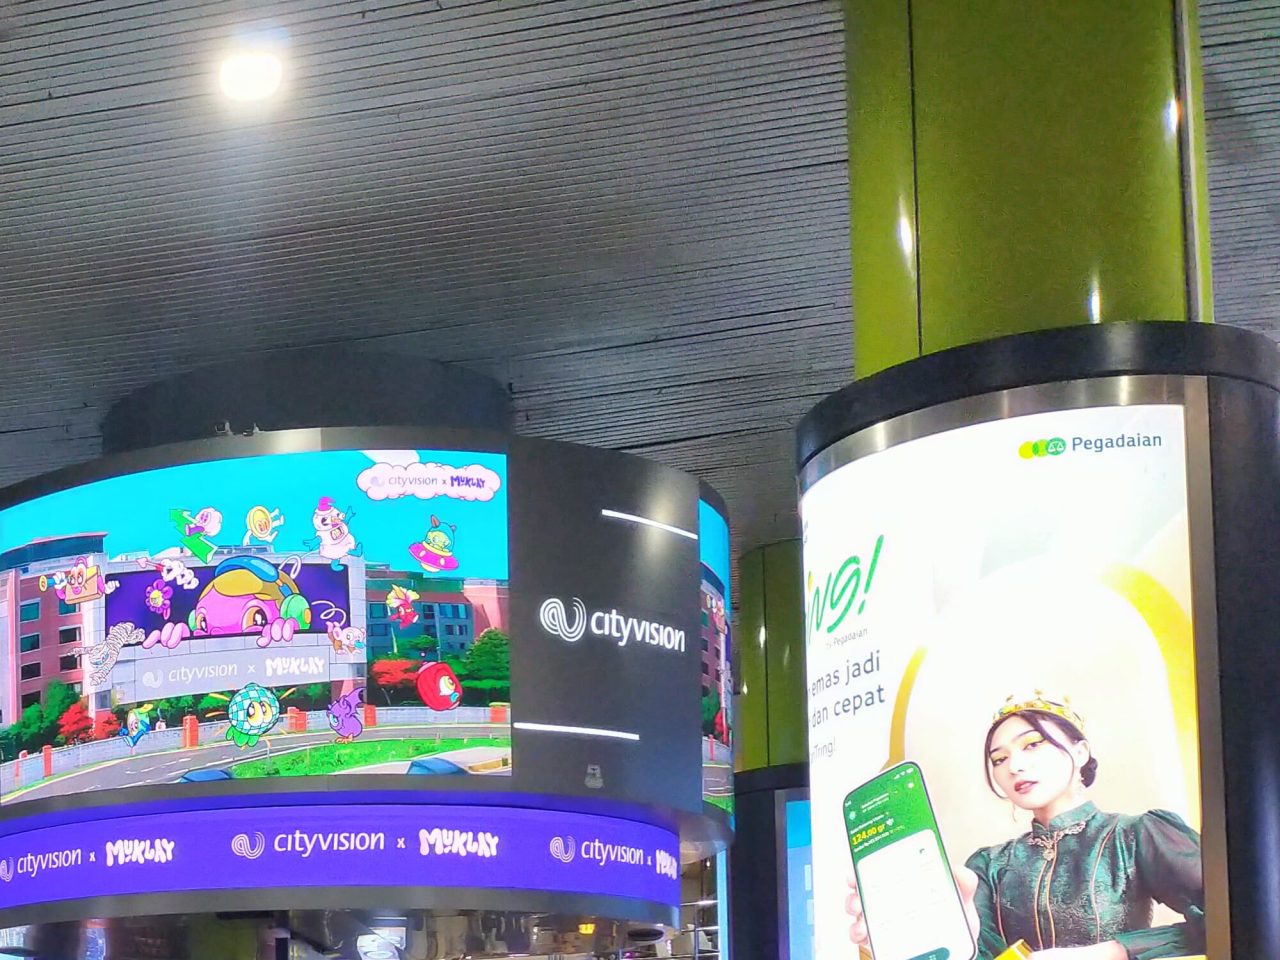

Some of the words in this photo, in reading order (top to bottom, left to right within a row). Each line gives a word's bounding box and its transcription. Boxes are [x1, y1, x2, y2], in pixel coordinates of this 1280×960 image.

[1071, 432, 1163, 453] Pegadaian
[388, 475, 438, 488] cityvision
[590, 608, 687, 652] cityvision
[168, 663, 238, 685] cityvision
[811, 668, 840, 697] emas
[844, 649, 881, 686] jadi
[812, 705, 829, 728] dan
[833, 685, 886, 716] cepat
[273, 829, 386, 858] cityvision
[396, 837, 406, 849] x
[580, 838, 645, 867] cityvision
[16, 847, 82, 878] cityvision
